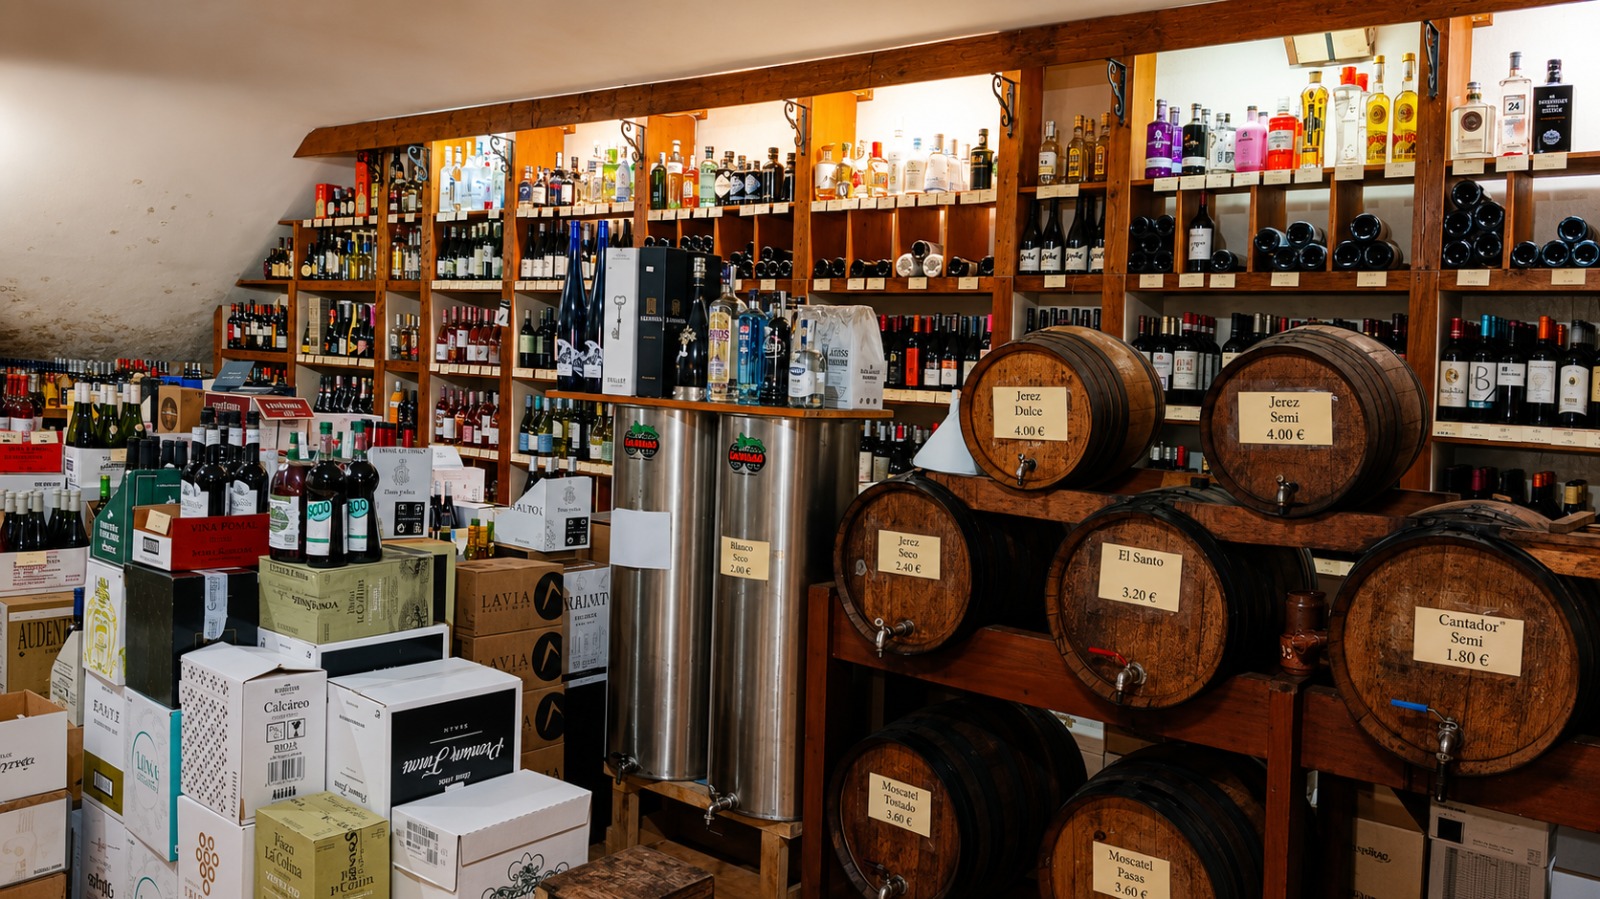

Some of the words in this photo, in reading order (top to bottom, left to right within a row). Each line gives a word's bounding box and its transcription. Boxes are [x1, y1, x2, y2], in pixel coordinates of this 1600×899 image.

[1508, 102, 1520, 111] 24
[1016, 391, 1041, 402] Jerez
[1269, 396, 1300, 408] Jerez
[1015, 406, 1043, 416] Dulce
[1271, 411, 1299, 423] Semi
[1014, 425, 1035, 436] 4.00
[1038, 426, 1045, 436] €
[1267, 429, 1293, 440] 4.00
[1297, 429, 1304, 440] €
[731, 541, 753, 552] Blanco
[898, 536, 920, 547] Jerez
[733, 553, 748, 562] Seco
[898, 548, 918, 559] Seco
[1118, 549, 1130, 561] El
[1133, 552, 1164, 567] Santo
[730, 564, 745, 574] 2.00
[746, 567, 751, 575] €
[896, 561, 913, 572] 2.40
[915, 564, 921, 573] €
[482, 591, 530, 609] LAVIA
[1122, 587, 1146, 601] 3.20
[1149, 592, 1157, 603] €
[1451, 631, 1483, 647] Semi
[480, 654, 528, 670] AVIA
[1447, 649, 1476, 664] 1.80
[1480, 654, 1489, 667] €
[882, 780, 918, 800] Moscatel
[884, 794, 916, 812] Tostado
[887, 810, 904, 823] 3.60
[906, 817, 912, 827] €
[277, 852, 302, 879] Colina
[1109, 850, 1153, 871] Moscatel
[1117, 867, 1145, 883] Pasas
[1115, 882, 1137, 897] 3.60
[1141, 890, 1148, 899] €
